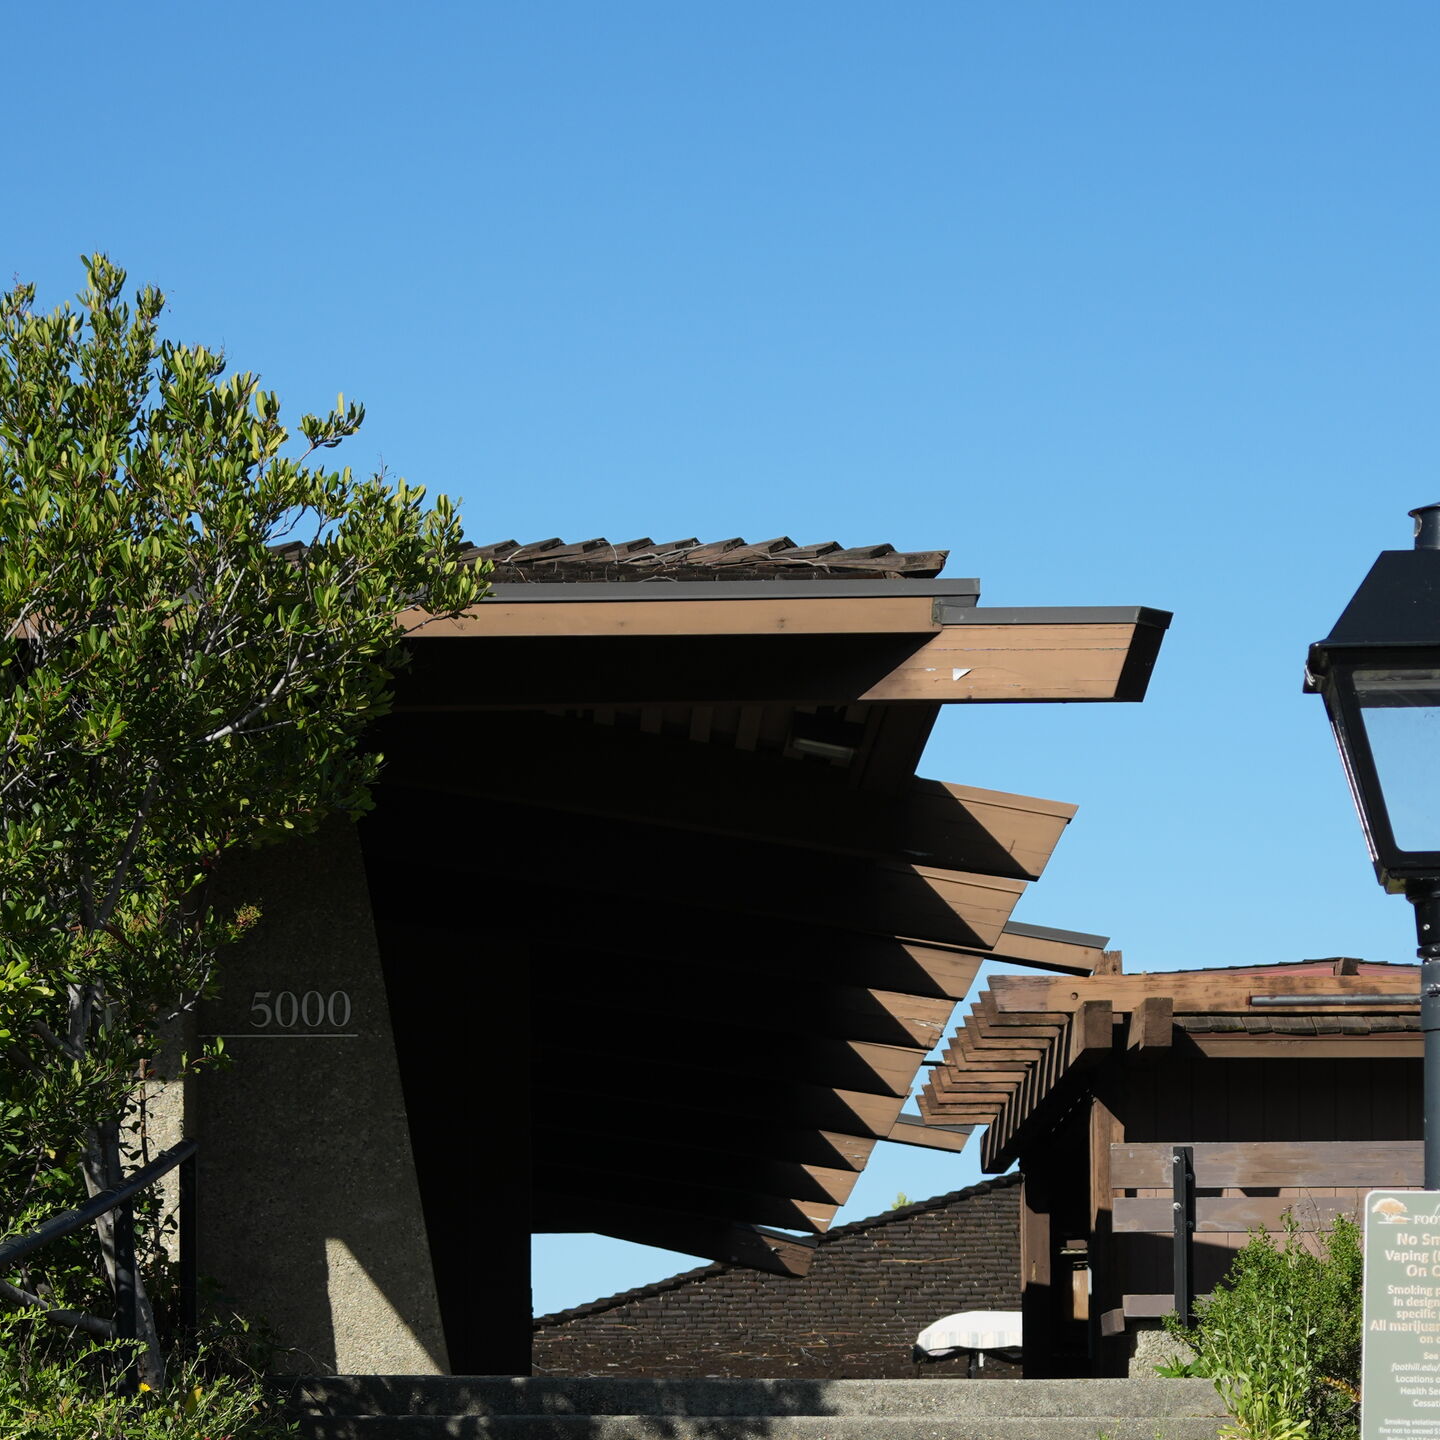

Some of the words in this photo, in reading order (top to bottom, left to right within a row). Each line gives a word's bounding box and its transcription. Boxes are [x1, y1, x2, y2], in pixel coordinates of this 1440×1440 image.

[249, 990, 351, 1028] 5000
[1397, 1233, 1418, 1246] No
[1385, 1250, 1429, 1263] Vaping
[1406, 1264, 1427, 1277] On
[1387, 1284, 1433, 1296] Smoking
[1393, 1297, 1404, 1307] in
[1397, 1309, 1436, 1320] specific
[1370, 1320, 1387, 1331] All
[1419, 1335, 1433, 1344] on
[1423, 1351, 1439, 1360] See
[1395, 1374, 1434, 1384] Locations
[1400, 1386, 1427, 1395] Health
[1384, 1418, 1411, 1427] Smoking
[1378, 1426, 1391, 1434] fine
